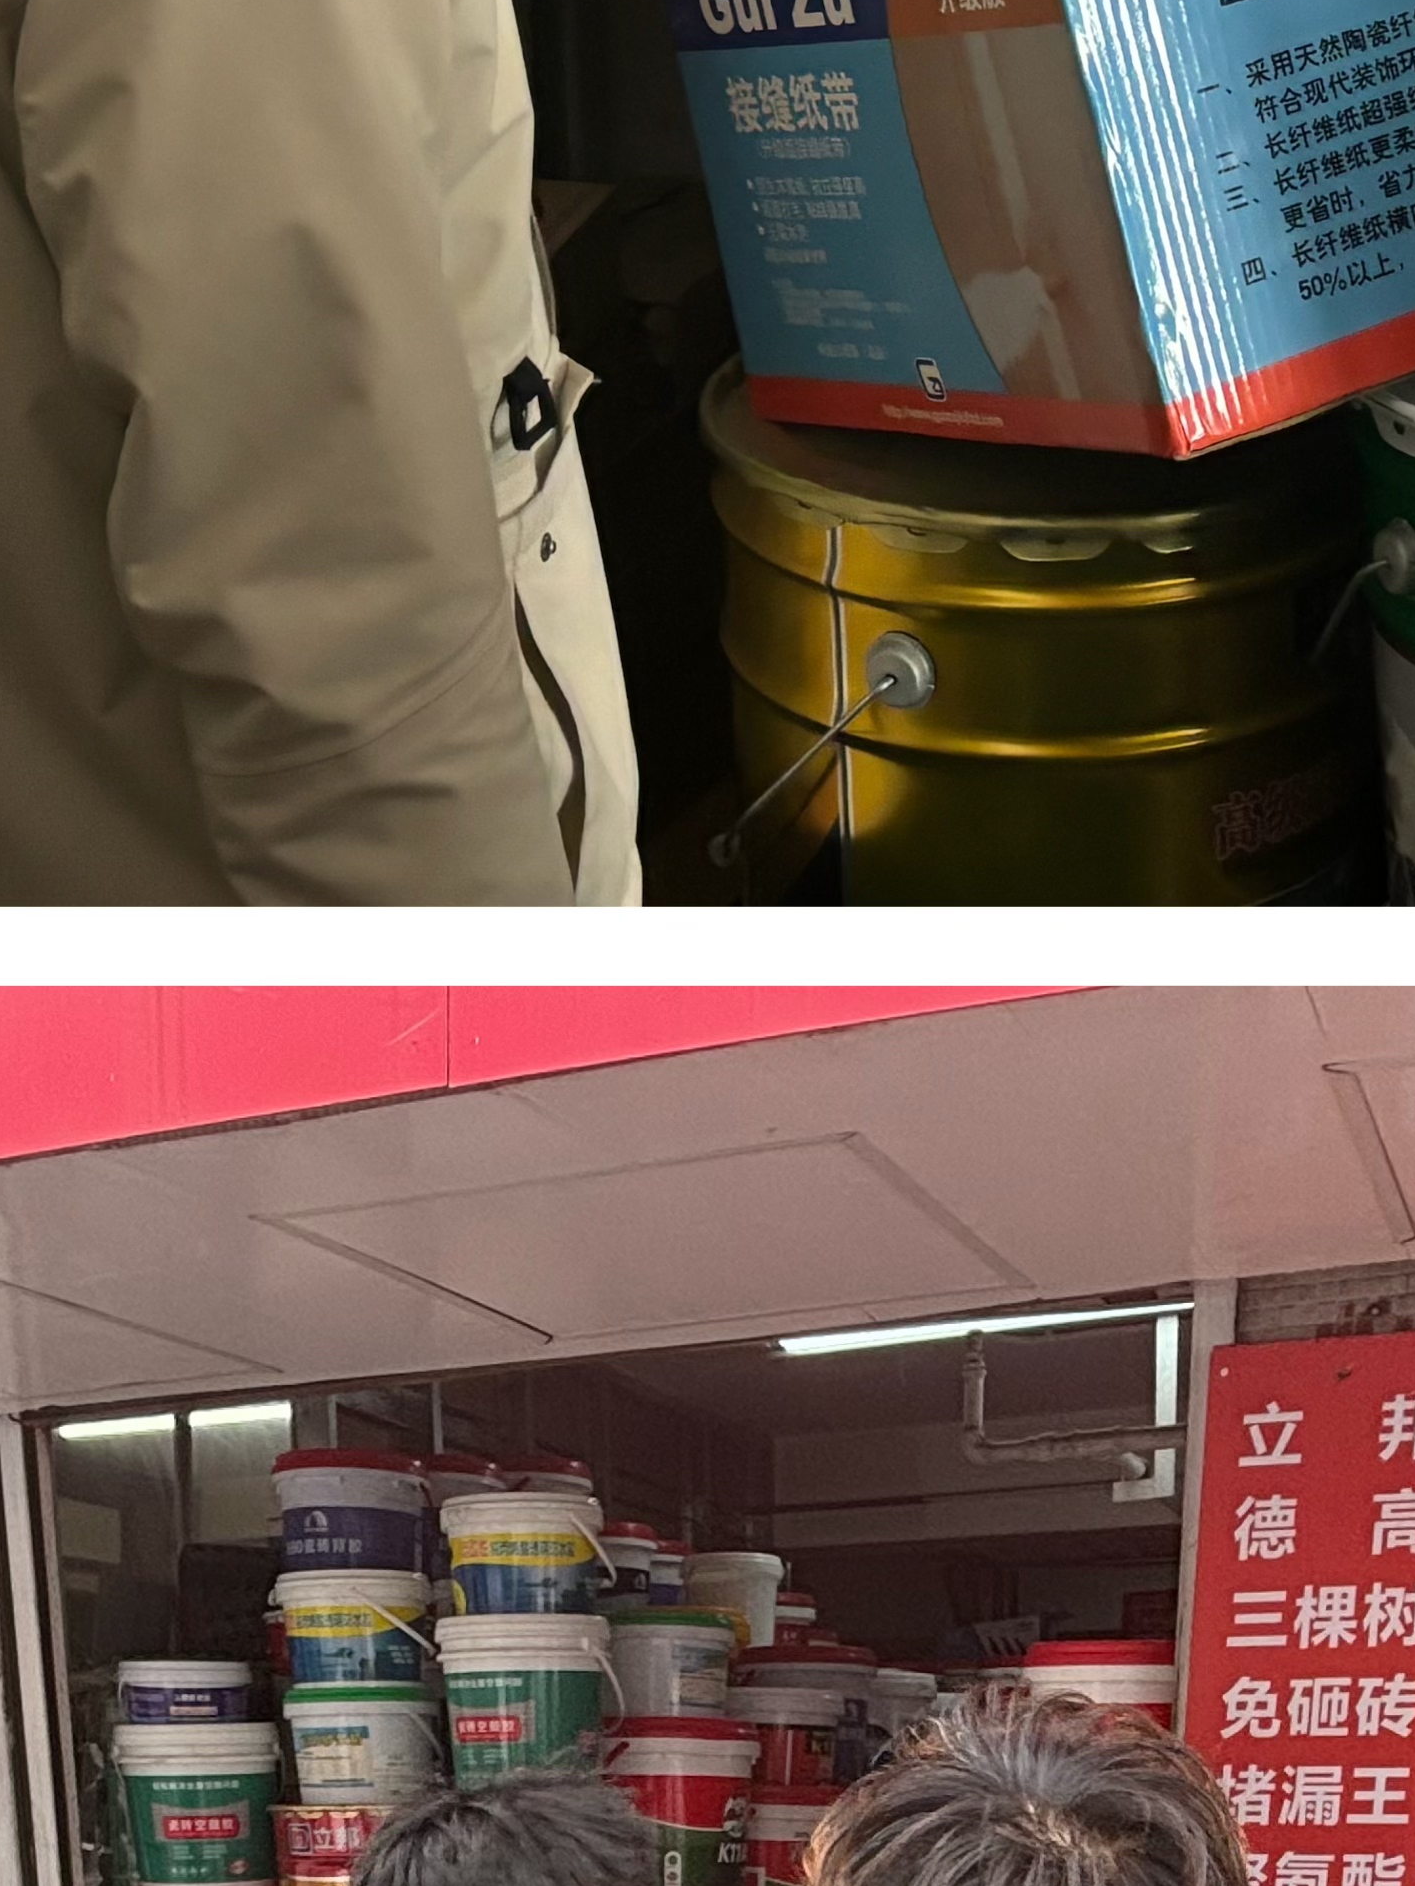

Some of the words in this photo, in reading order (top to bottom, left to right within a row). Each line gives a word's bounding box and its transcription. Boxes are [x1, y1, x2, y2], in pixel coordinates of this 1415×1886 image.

[724, 69, 861, 134] 接缝纸带
[1236, 1402, 1304, 1466] 立
[1234, 1493, 1297, 1561] 德
